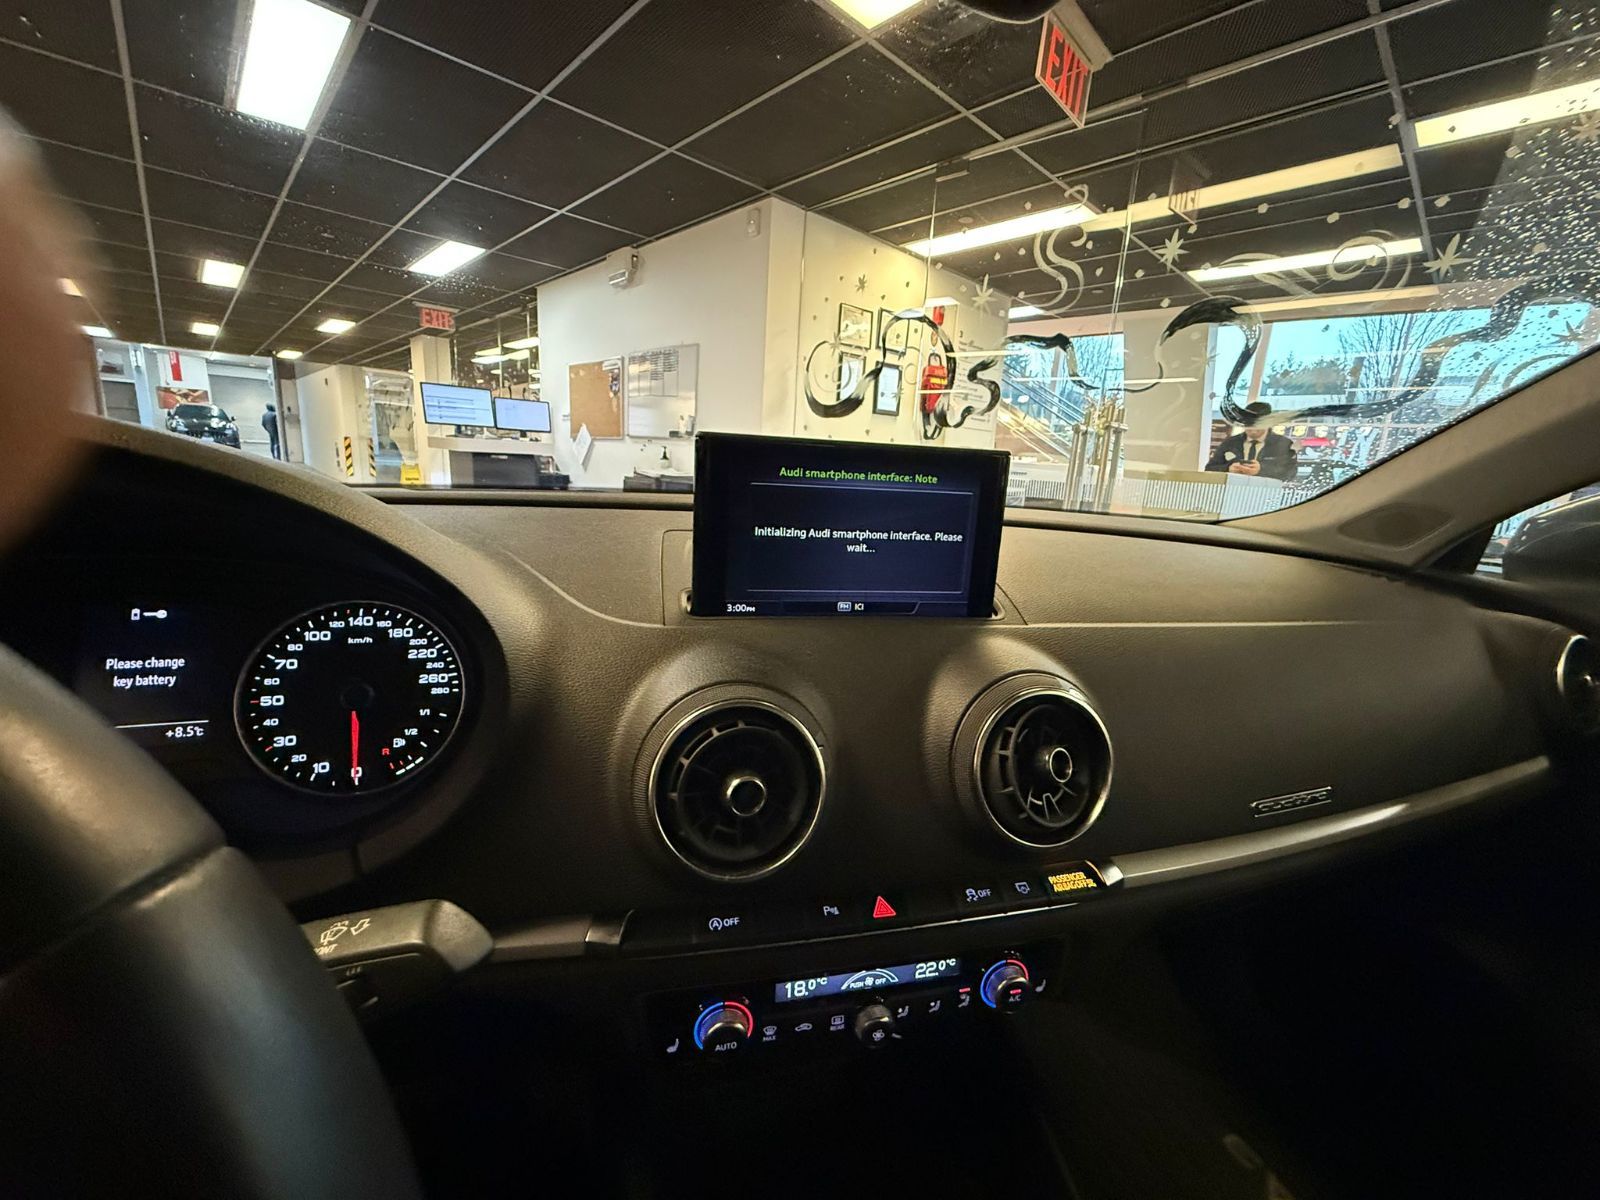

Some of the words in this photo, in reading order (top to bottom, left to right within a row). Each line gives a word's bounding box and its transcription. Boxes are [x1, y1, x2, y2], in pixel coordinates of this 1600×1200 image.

[1045, 25, 1089, 117] EXIT
[422, 308, 449, 328] EXIT
[779, 467, 804, 478] Audi
[805, 470, 866, 483] smartphone
[867, 472, 914, 483] interface:
[915, 474, 939, 485] Note
[754, 527, 807, 540] Initializing
[808, 528, 831, 539] Audi
[832, 530, 889, 542] smartphone
[890, 531, 933, 542] interface.
[934, 532, 963, 543] Please
[846, 543, 876, 554] wait...
[329, 620, 345, 628] 120
[348, 616, 374, 627] 140
[303, 630, 331, 642] 100
[387, 627, 414, 638] 180
[347, 636, 373, 644] km/h
[409, 638, 428, 646] 200
[287, 643, 304, 652] 80
[407, 648, 438, 659] 220
[105, 657, 144, 670] Please
[144, 656, 186, 670] change
[274, 658, 299, 670] 70
[425, 661, 445, 669] 240
[113, 675, 133, 689] key
[135, 674, 177, 688] battery
[263, 677, 281, 686] 60
[418, 673, 449, 684] 260
[259, 694, 285, 707] 50
[419, 708, 431, 716] 1/1
[262, 718, 279, 727] 40
[404, 728, 419, 736] 1/2
[273, 735, 297, 748] 30
[381, 748, 391, 756] R
[290, 753, 307, 763] 20
[312, 761, 330, 774] 10
[350, 766, 363, 778] 0
[977, 888, 992, 898] OFF
[723, 916, 741, 927] OFF
[875, 977, 887, 985] OFF
[714, 1041, 739, 1053] AUTO
